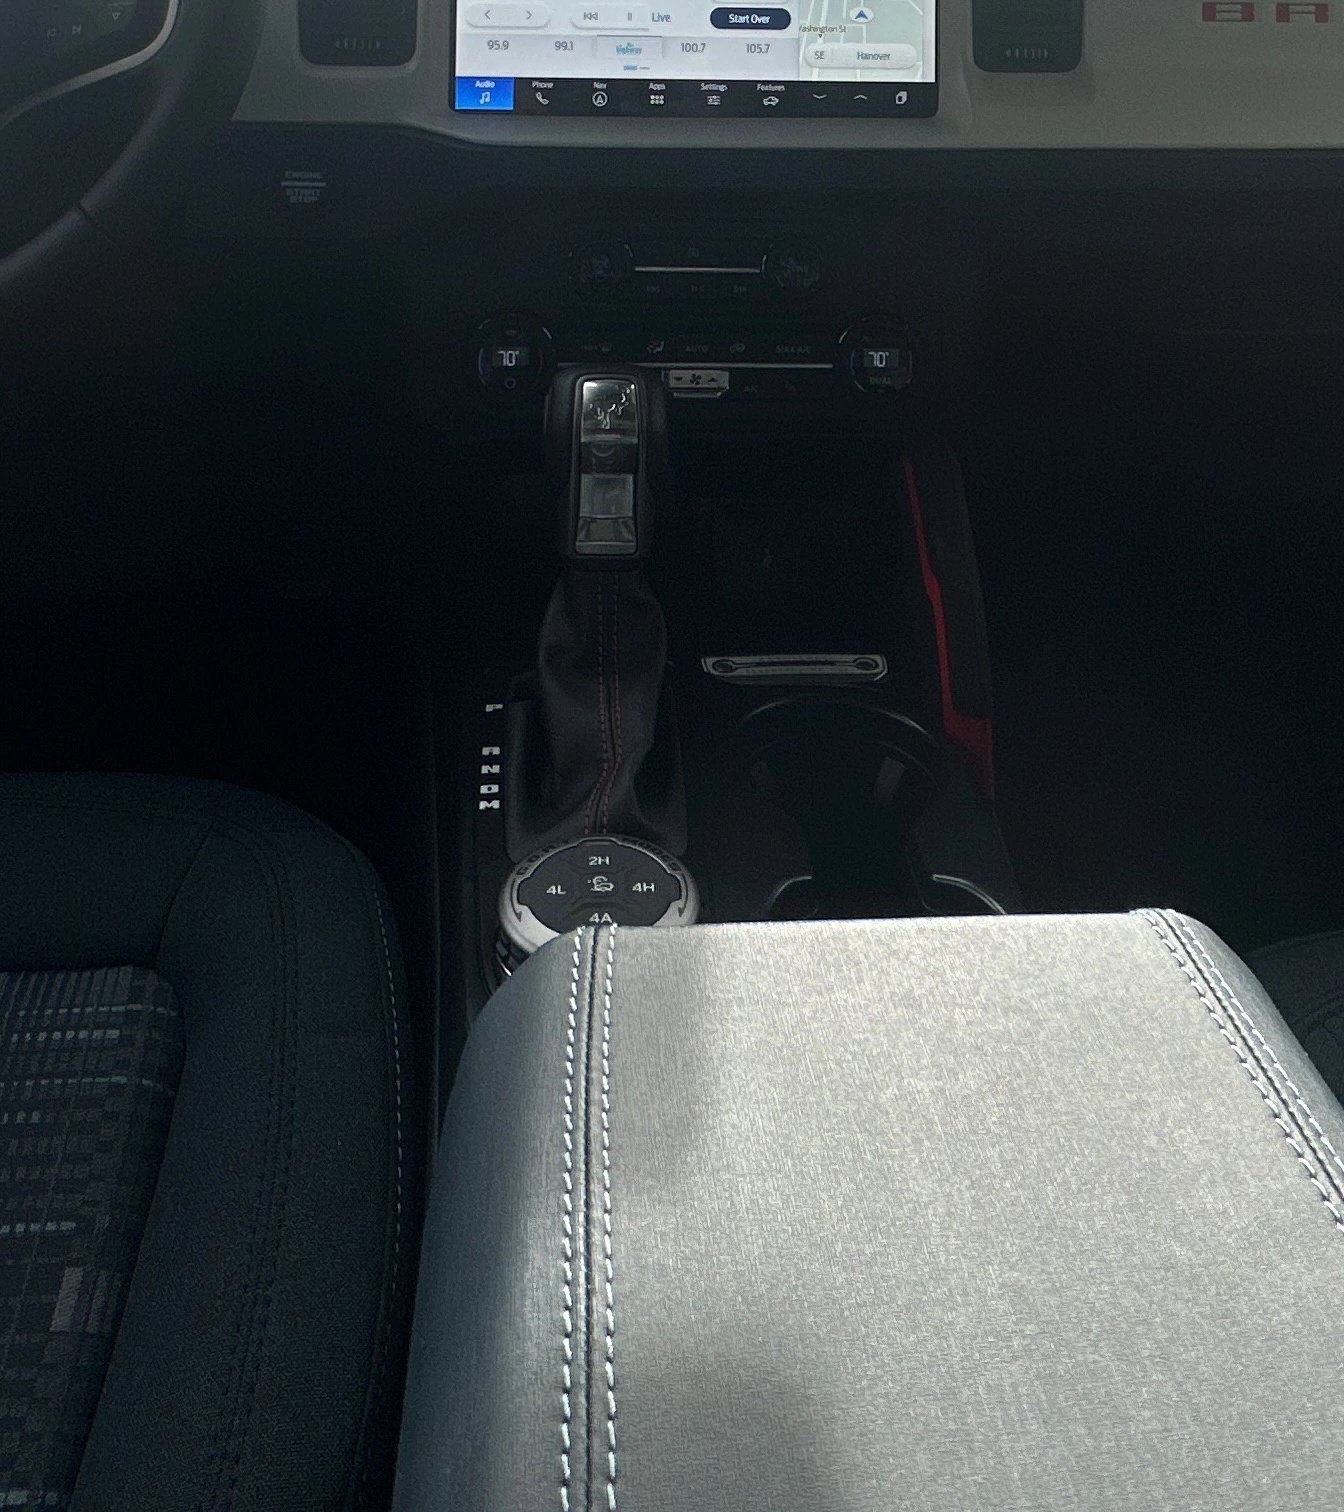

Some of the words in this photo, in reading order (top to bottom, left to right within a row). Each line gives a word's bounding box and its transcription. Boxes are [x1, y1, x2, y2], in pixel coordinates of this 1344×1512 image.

[652, 12, 671, 23] Live
[728, 13, 750, 24] Start
[750, 13, 771, 25] Over
[487, 40, 509, 51] 95.9
[554, 41, 574, 51] 99.1
[680, 42, 706, 53] 100.7
[746, 43, 771, 54] 105.7
[814, 50, 825, 60] SE
[856, 51, 891, 61] Hanover
[474, 80, 495, 89] Audio
[531, 81, 554, 89] Phone
[593, 81, 607, 90] Nav
[648, 82, 666, 91] Apps
[700, 83, 729, 92] Settings
[480, 764, 501, 775] N
[478, 799, 501, 811] M
[587, 855, 611, 867] 2H
[545, 884, 568, 896] 4L
[630, 882, 657, 894] 4H
[587, 912, 614, 925] 4A
